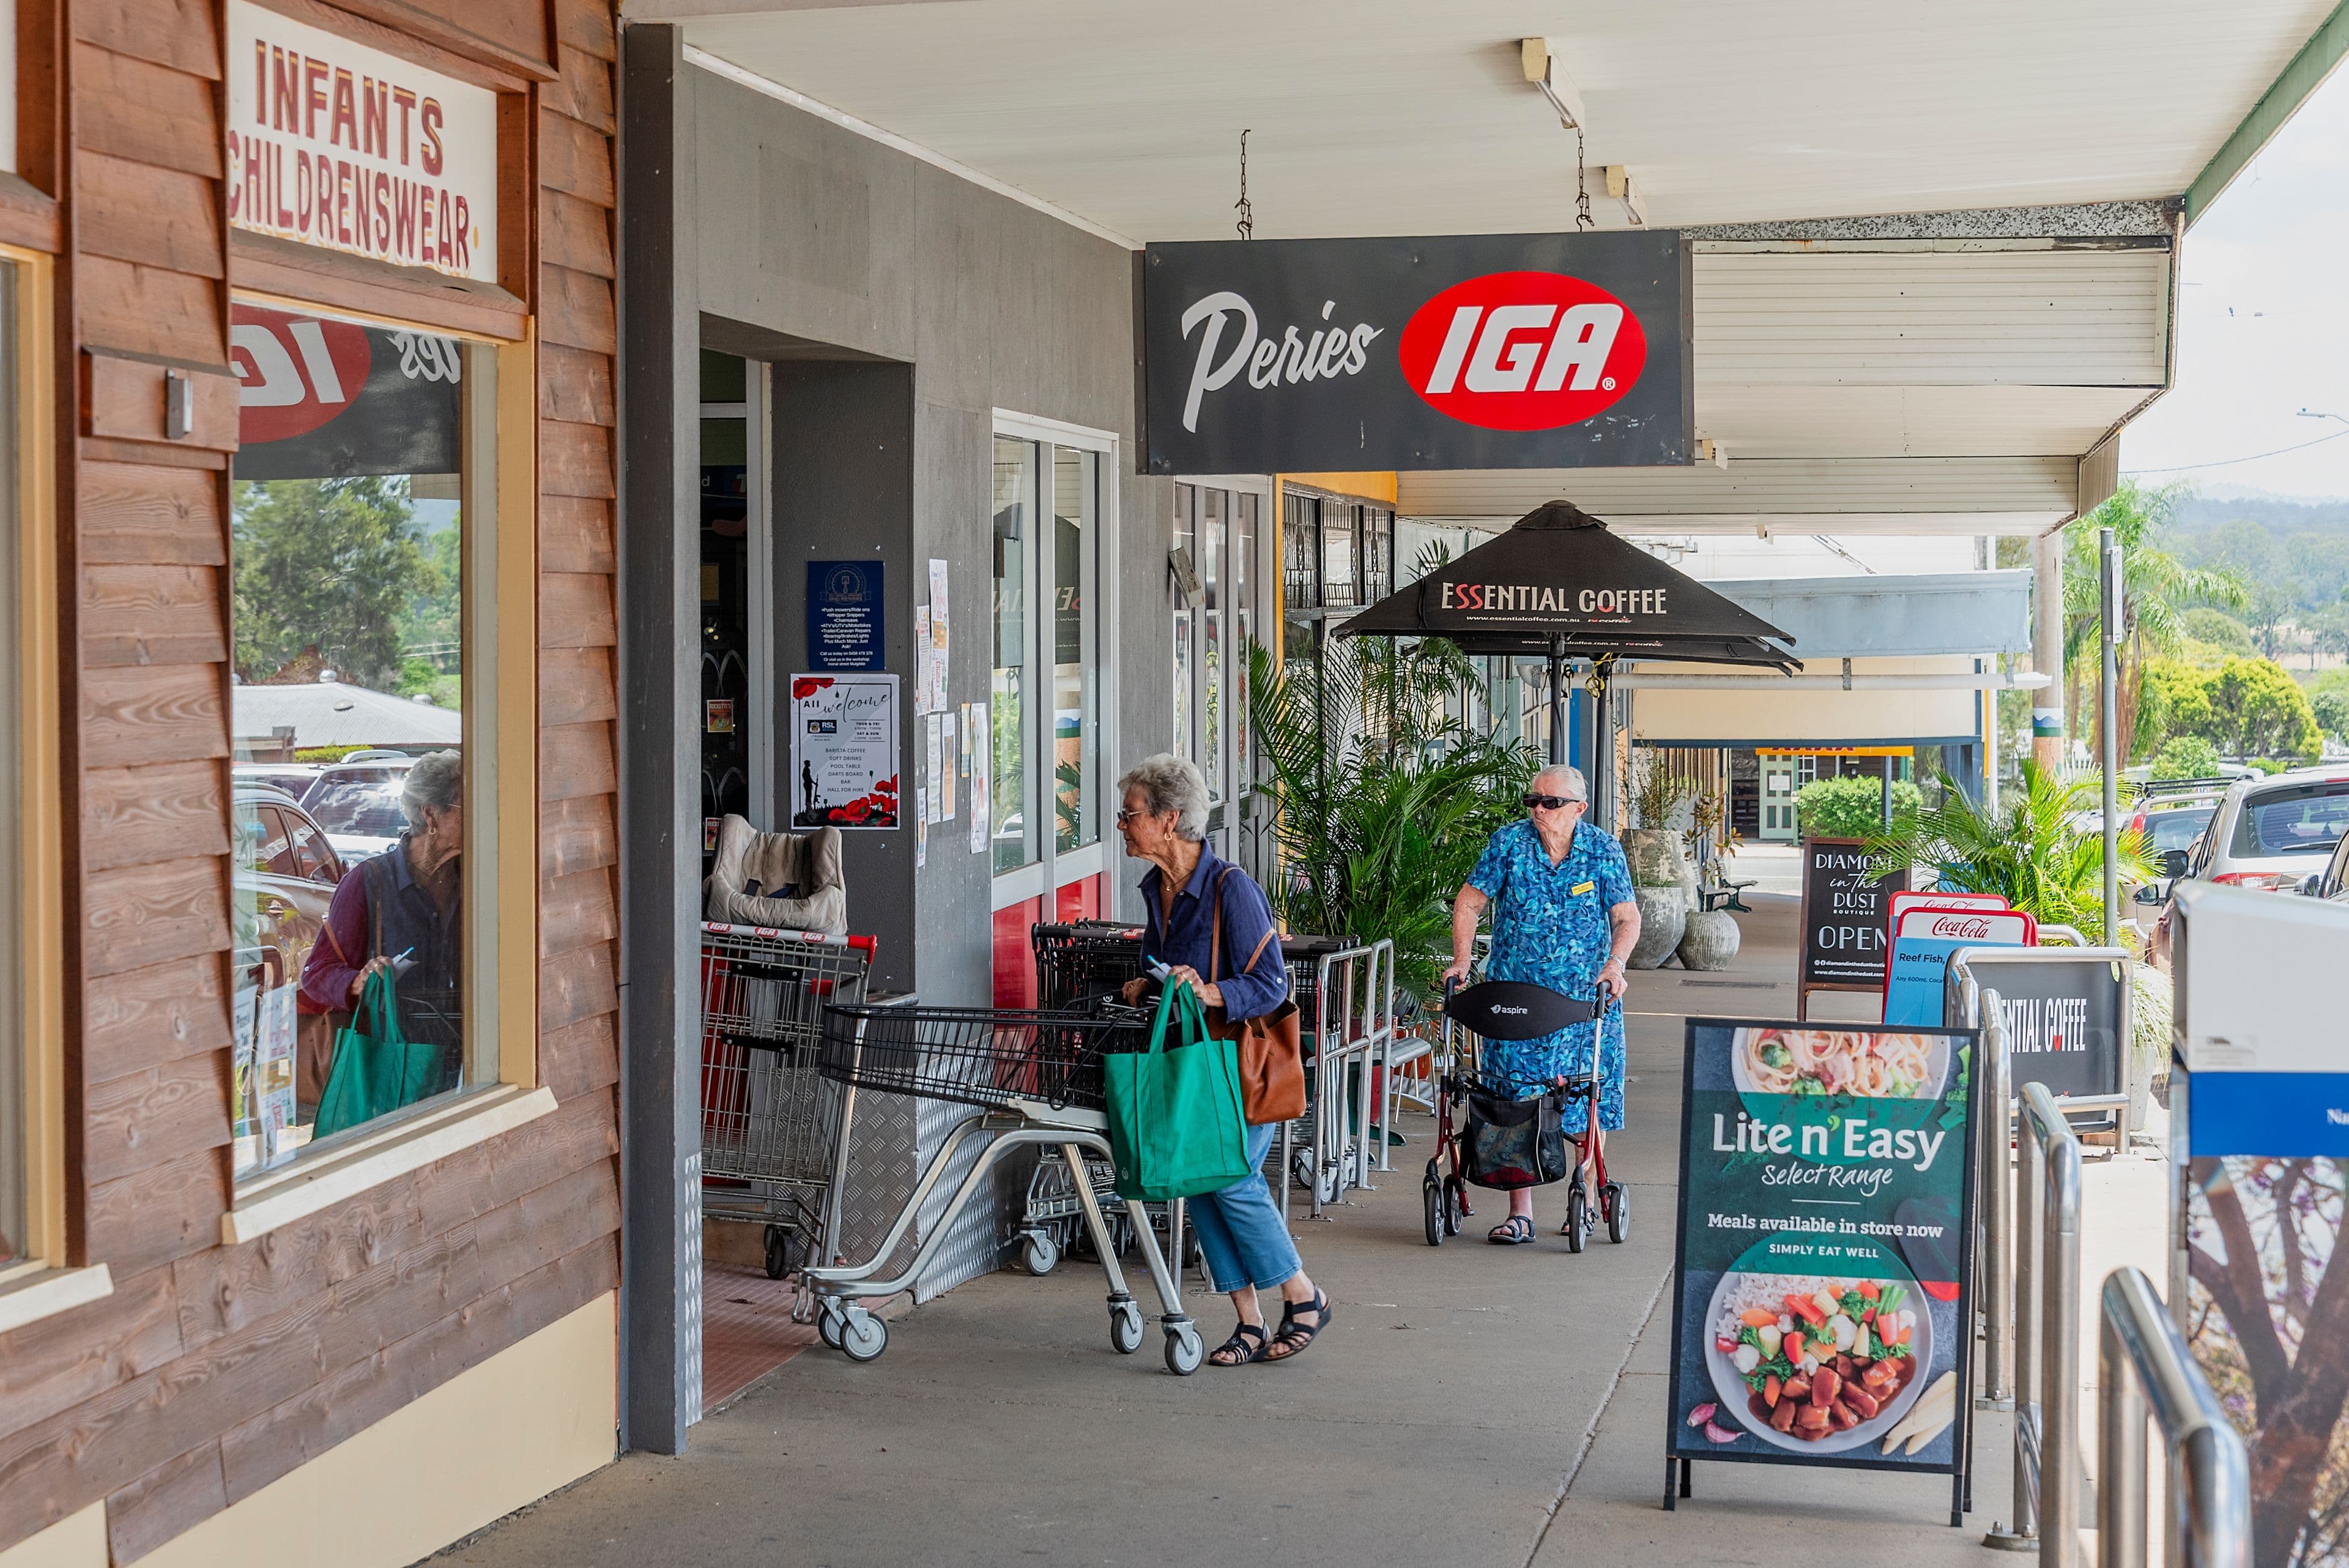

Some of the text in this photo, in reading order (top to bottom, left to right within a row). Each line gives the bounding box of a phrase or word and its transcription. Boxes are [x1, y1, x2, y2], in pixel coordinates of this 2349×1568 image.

[254, 39, 444, 177] INFANTS
[228, 129, 471, 273] CHILDRENSWEAR
[1181, 291, 1624, 433] Peries IGA
[1441, 582, 1667, 614] ESSENTIAL COFFEE
[818, 687, 891, 723] welcome
[1830, 878, 1850, 887] in
[1833, 892, 1878, 908] DUST
[757, 927, 776, 936] IGA
[804, 932, 823, 941] IGA
[1819, 926, 1887, 951] OPEN
[1932, 916, 1994, 938] Coca-Cola
[1899, 953, 1945, 965] Reef Fish,
[1501, 1005, 1527, 1015] aspire
[2001, 998, 2087, 1053] NTIAL COFFEE
[1713, 1110, 1792, 1156] Lite
[1761, 1161, 1893, 1197] Select Range
[1707, 1213, 1943, 1238] Meals available in store now
[1768, 1243, 1879, 1258] SIMPLY EAT WELL
